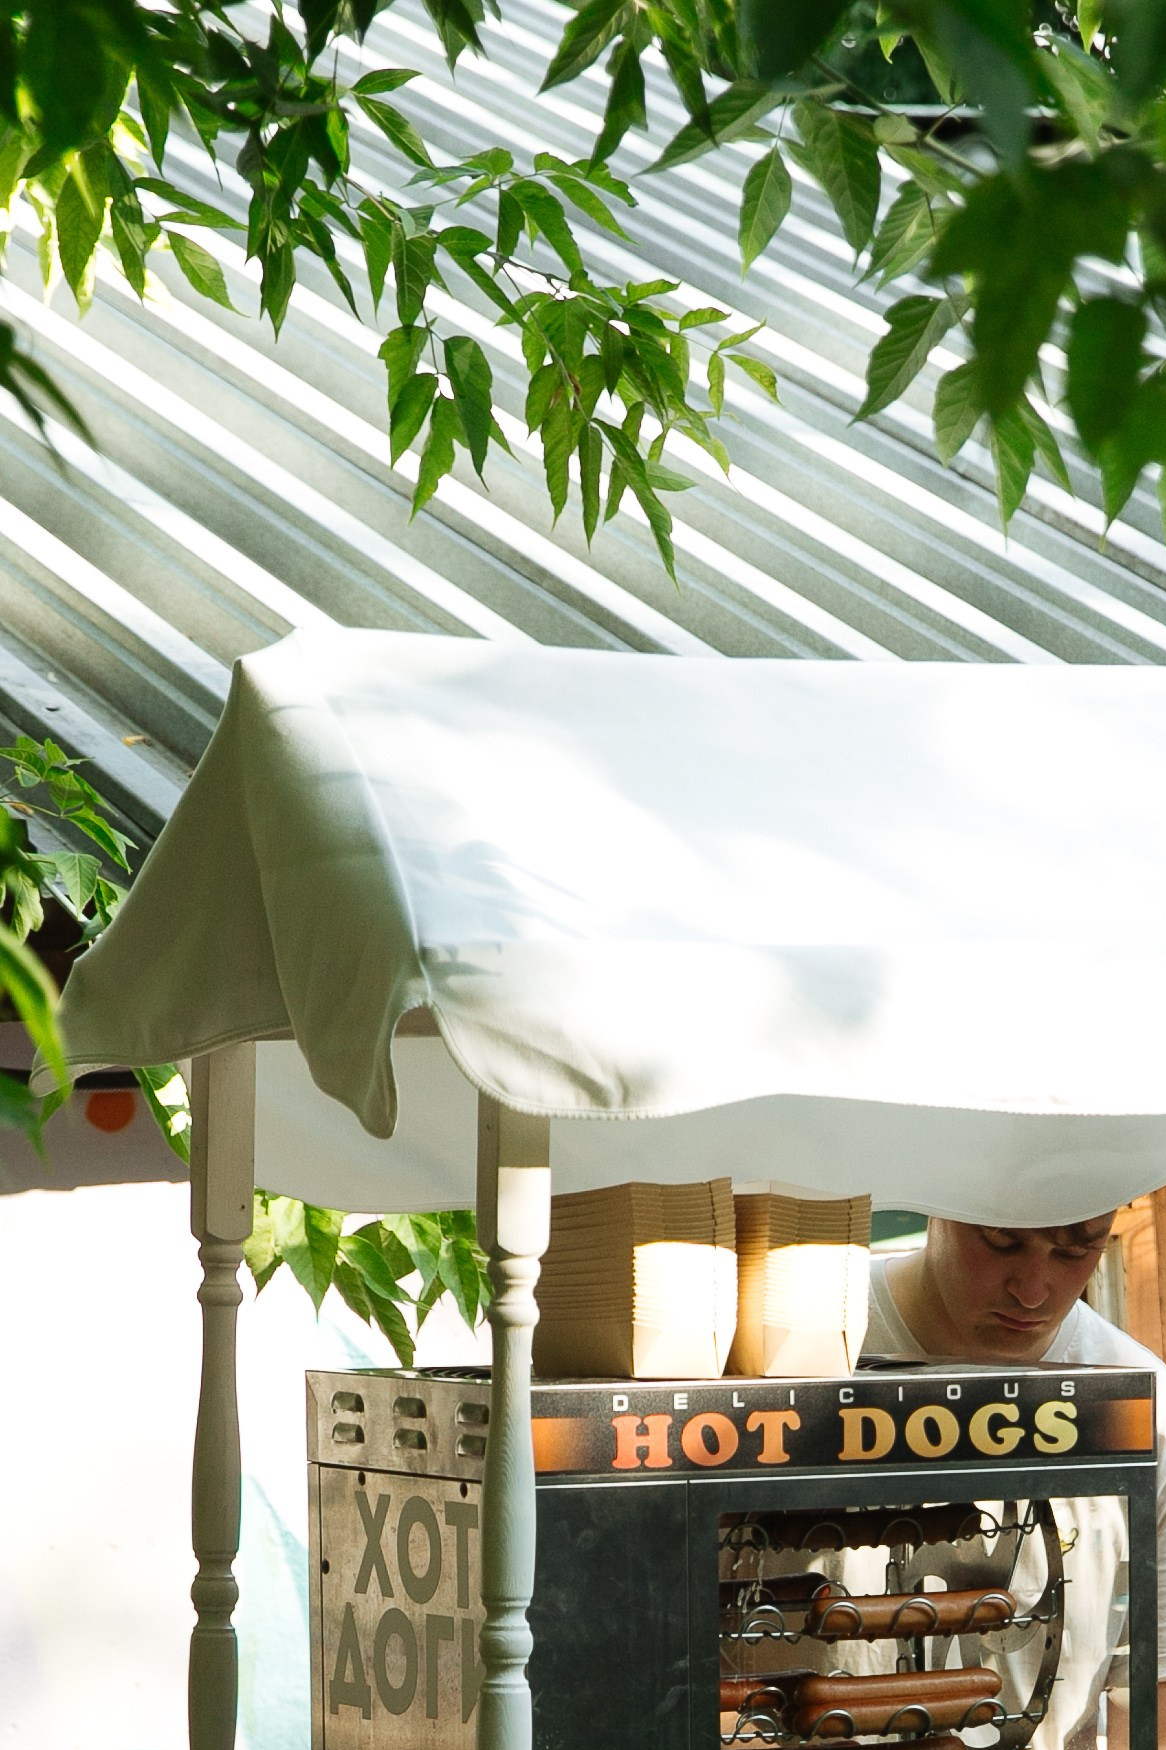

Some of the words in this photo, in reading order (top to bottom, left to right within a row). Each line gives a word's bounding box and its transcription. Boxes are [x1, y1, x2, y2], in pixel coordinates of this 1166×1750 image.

[612, 1380, 1076, 1412] DELICIOUS
[611, 1410, 801, 1469] HOT
[838, 1400, 1079, 1461] DOGS
[354, 1490, 479, 1609] ХОТ
